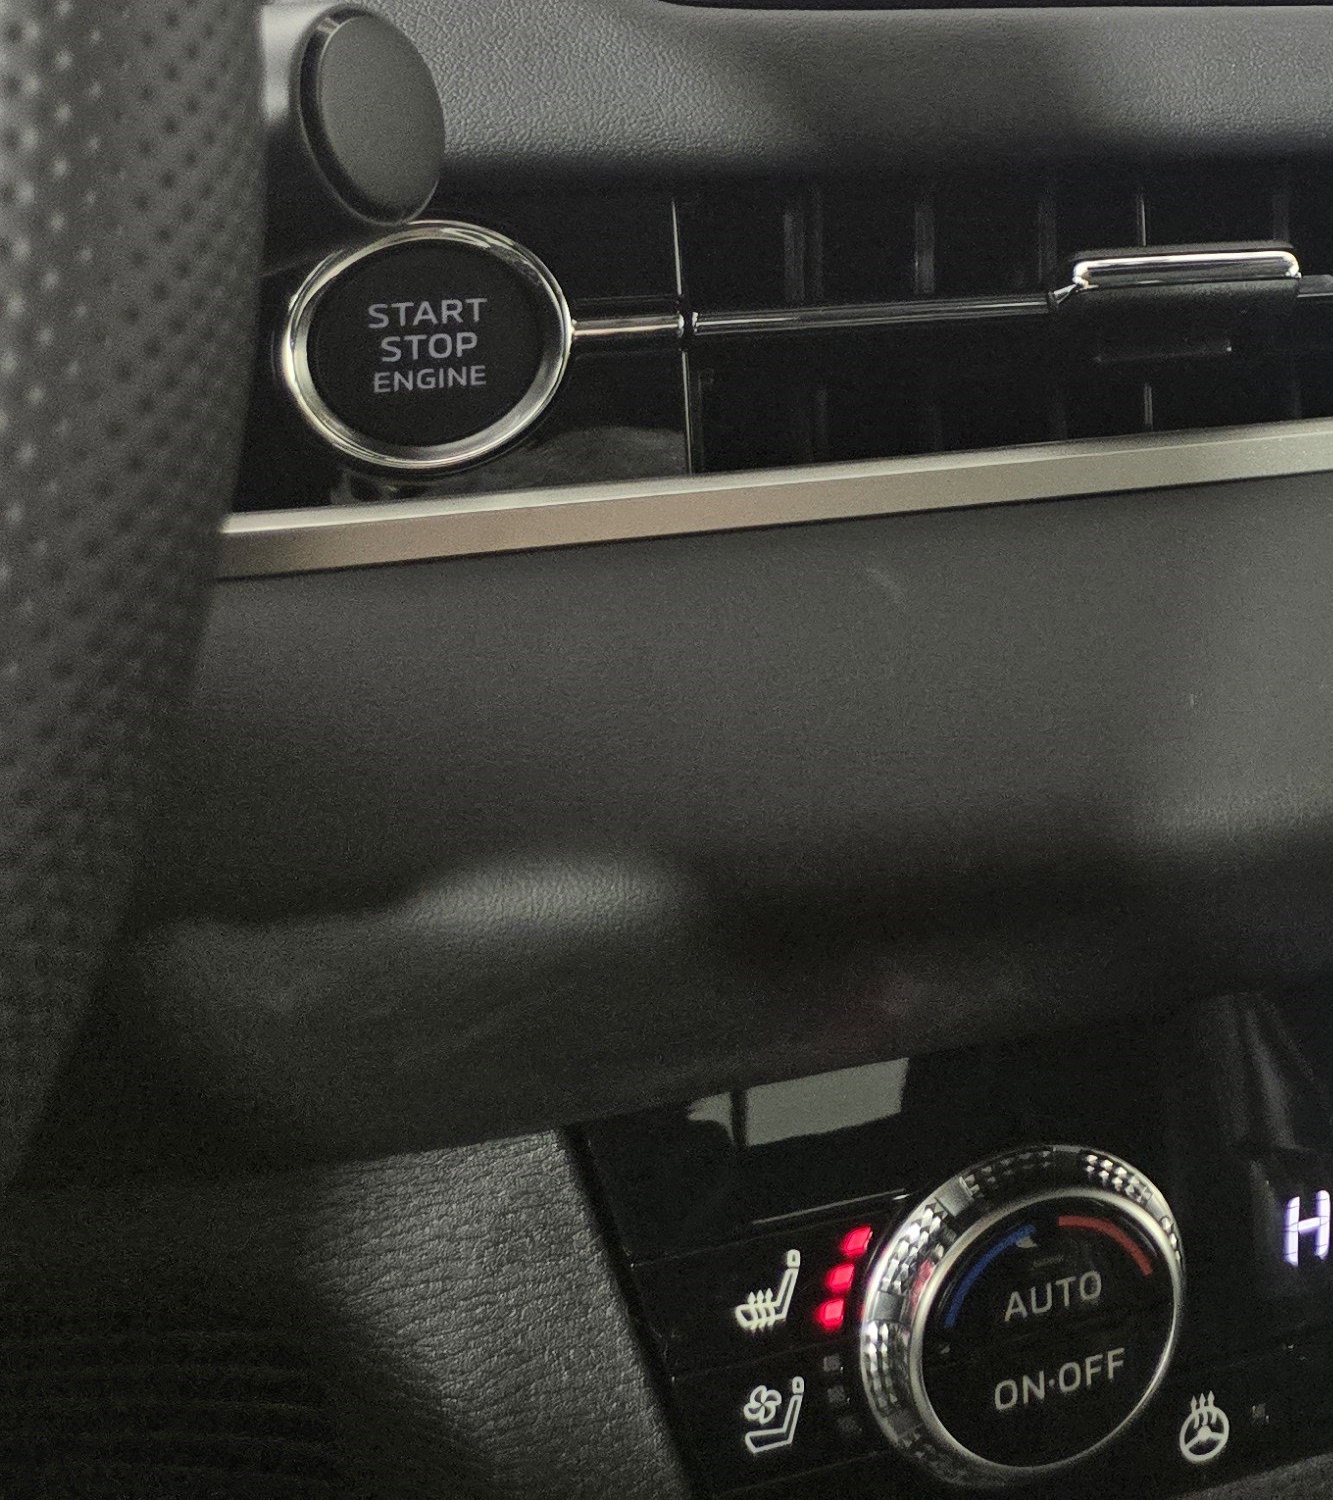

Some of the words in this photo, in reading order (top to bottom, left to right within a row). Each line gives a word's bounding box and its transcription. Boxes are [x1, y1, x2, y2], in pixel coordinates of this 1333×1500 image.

[367, 298, 488, 329] START
[380, 331, 478, 363] STOP
[373, 364, 487, 394] ENGINE
[1003, 1269, 1102, 1322] AUTO
